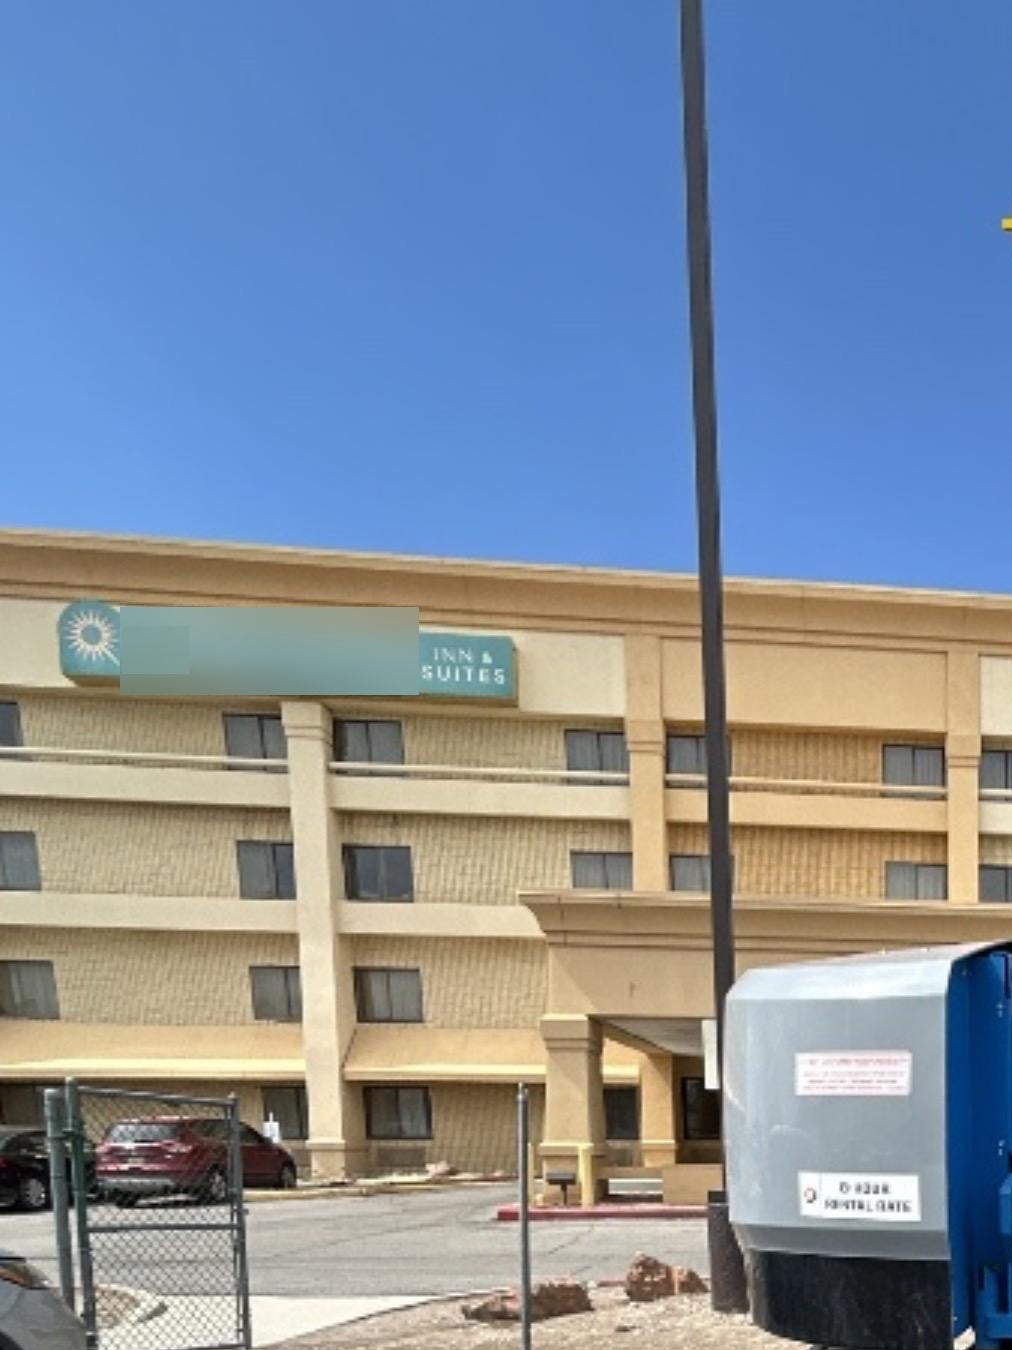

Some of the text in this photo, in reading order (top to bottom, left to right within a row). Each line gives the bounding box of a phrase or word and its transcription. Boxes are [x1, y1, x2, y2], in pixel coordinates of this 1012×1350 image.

[433, 647, 493, 665] INN &
[421, 664, 505, 685] SUITES
